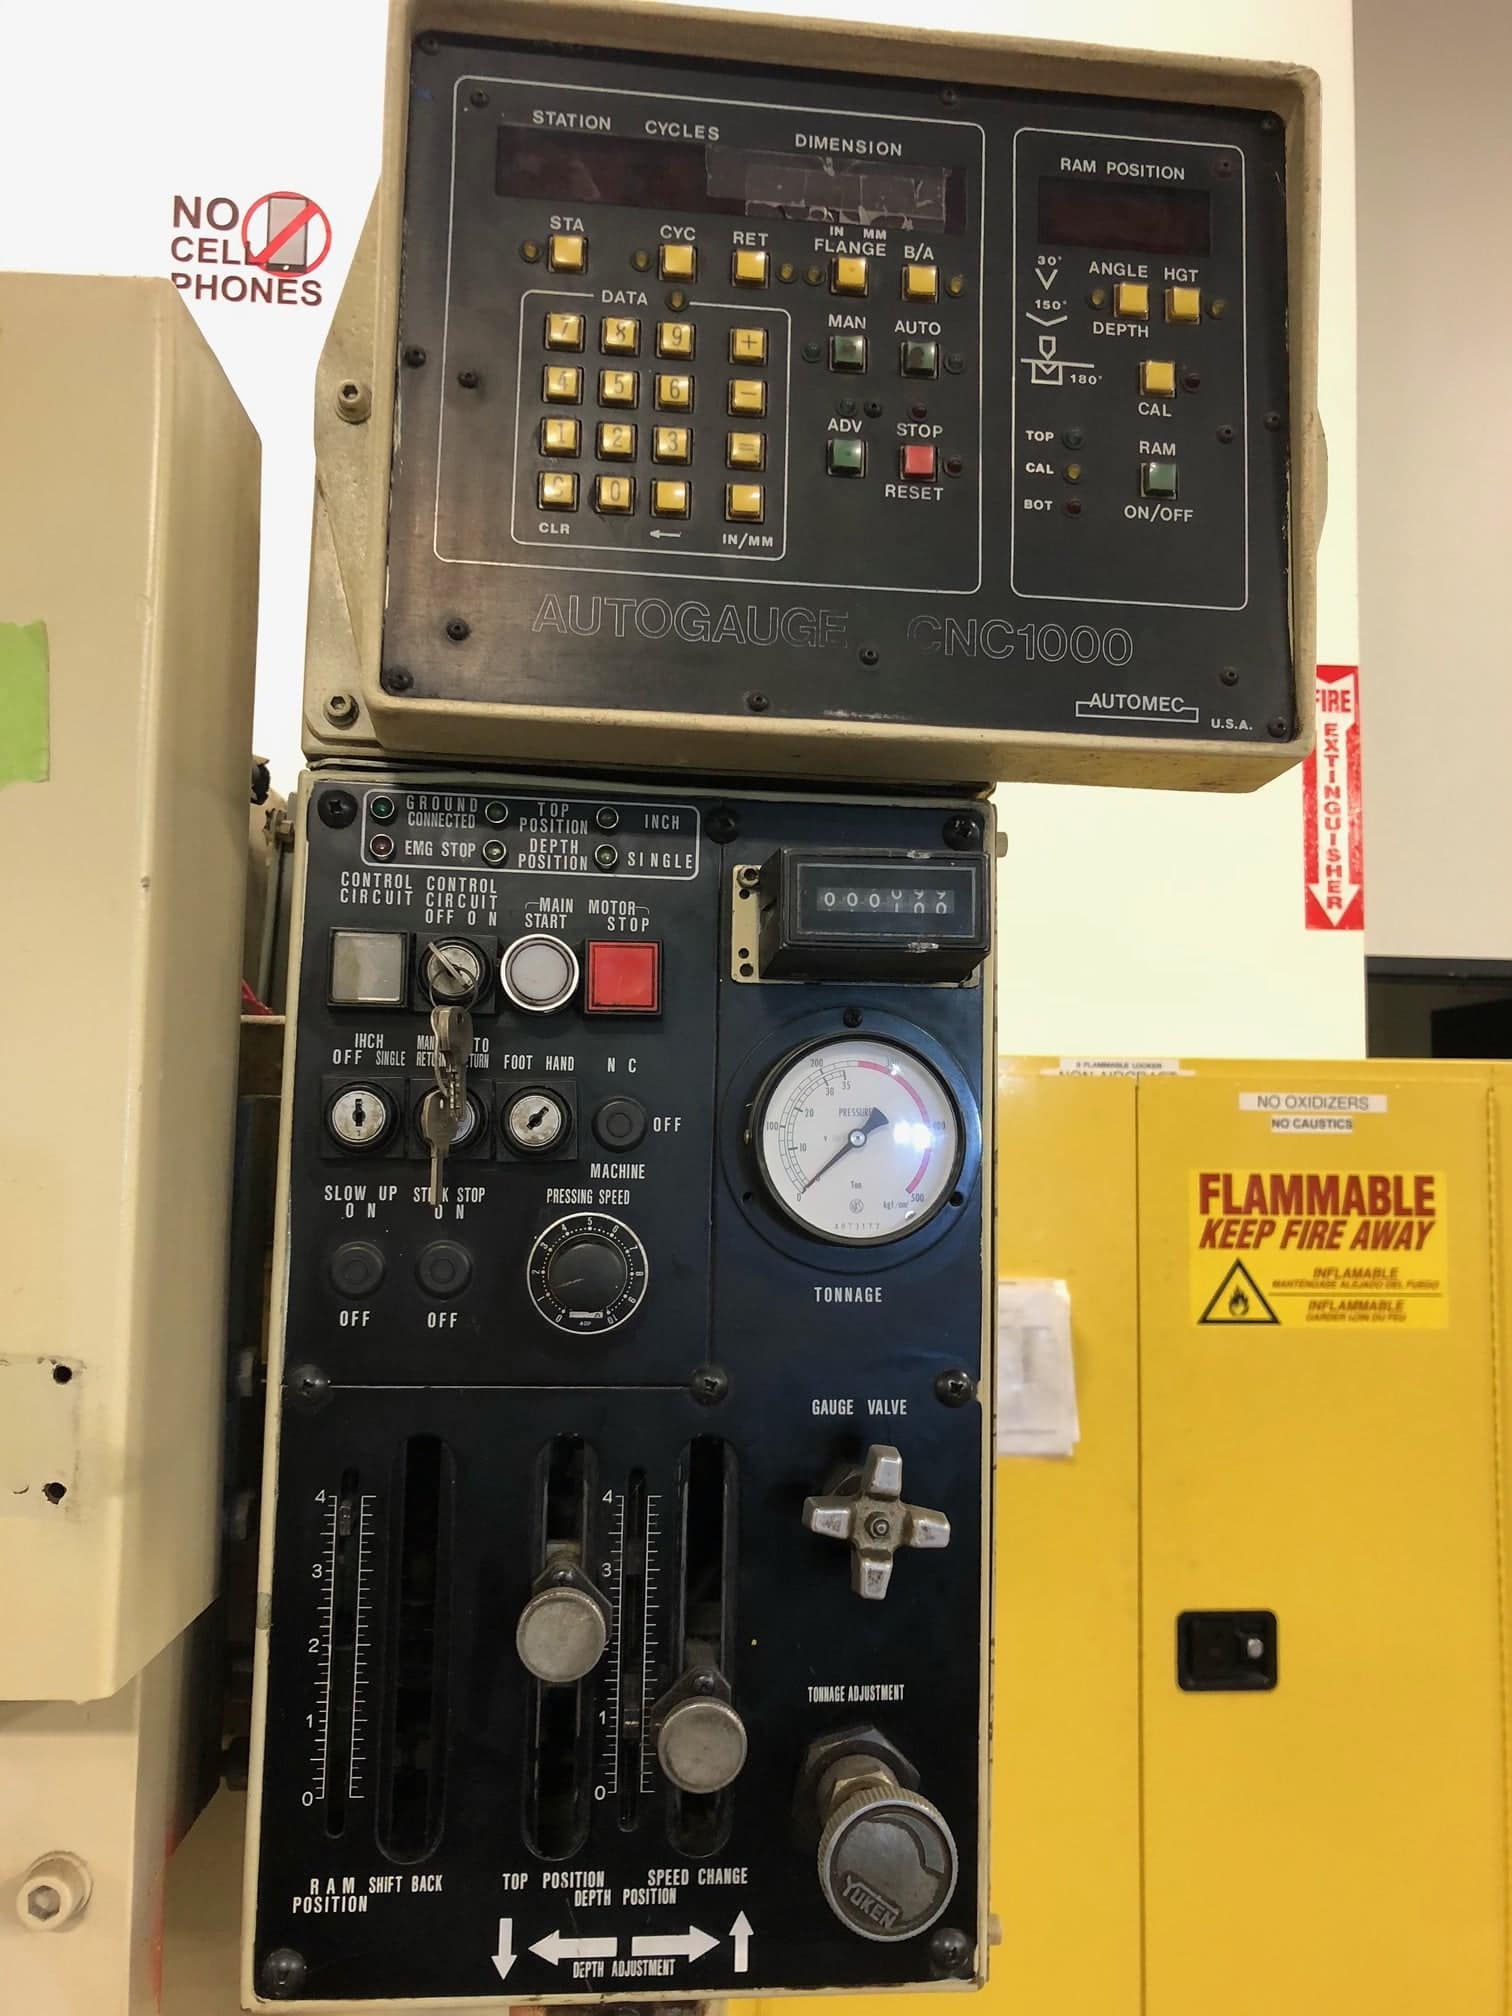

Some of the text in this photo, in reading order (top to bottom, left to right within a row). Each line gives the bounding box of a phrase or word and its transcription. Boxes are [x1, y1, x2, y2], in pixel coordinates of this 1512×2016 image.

[533, 109, 611, 131] STATION
[645, 120, 720, 142] CYCLES
[795, 133, 903, 157] DIMENSION
[1061, 157, 1185, 180] RAM POSITION
[173, 195, 240, 231] NO
[550, 216, 585, 233] STA
[660, 225, 696, 241] CYC
[830, 226, 887, 240] IN MM
[733, 231, 769, 247] RET
[171, 236, 261, 266] CELL
[814, 239, 887, 257] FLANGE
[904, 245, 935, 261] B/A
[1089, 261, 1148, 278] ANGLE
[1164, 267, 1199, 282] HGT
[171, 272, 322, 306] PHONES
[601, 290, 648, 306] DATA
[828, 314, 867, 330] MAN
[894, 320, 942, 336] AUTO
[1093, 321, 1149, 338] DEPTH
[672, 327, 682, 345] 9
[614, 373, 624, 392] 5
[670, 379, 680, 399] 6
[1138, 402, 1172, 417] CAL
[827, 418, 863, 433] ADV
[896, 423, 943, 438] STOP
[612, 428, 623, 448] 2
[668, 431, 678, 451] 3
[1026, 430, 1054, 442] TOP
[1139, 441, 1176, 456] RAM
[1026, 463, 1054, 474] CAL
[885, 484, 944, 500] RESET
[1024, 500, 1053, 511] BOT
[1124, 504, 1193, 522] ON/OFF
[539, 523, 570, 535] CLR
[722, 532, 774, 549] IN/MM
[531, 593, 1133, 666] AUTOGAUGE CNC1000
[1089, 693, 1185, 713] AUTOMEC
[1316, 689, 1351, 713] IRE
[1211, 718, 1253, 731] U.S.A.
[406, 795, 479, 813] GROUND
[537, 802, 569, 817] TOP
[408, 811, 476, 829] CONNECTED
[645, 814, 680, 830] INCH
[1323, 723, 1342, 909] EXTINGUISHER
[520, 818, 588, 835] POSITION
[405, 840, 476, 858] EMG STOP
[530, 838, 578, 854] DEPTH
[518, 854, 588, 871] POSITION
[628, 851, 693, 869] SINGLE
[340, 872, 413, 890] CONTROL
[427, 876, 497, 894] CONTROL
[340, 888, 414, 906] CIRCUIT
[426, 892, 498, 909] CIRCUIT
[539, 897, 637, 916] MAIN MOTOR
[425, 909, 454, 925] OFF
[525, 913, 567, 929] START
[607, 916, 650, 932] STOP
[332, 1049, 406, 1066] OFF SINGLE
[466, 1053, 489, 1068] TURN
[504, 1055, 575, 1071] FOOT HAND
[1257, 1095, 1369, 1110] NO OXIDIZERS
[653, 1117, 682, 1132] OFF
[1272, 1118, 1352, 1130] NO CAUSTICS
[590, 1163, 645, 1180] MACHINE
[324, 1184, 397, 1201] SLOW UP
[457, 1187, 486, 1203] STOP
[547, 1188, 630, 1205] PRESSING SPEED
[1199, 1173, 1436, 1217] FLAMMABLE
[1199, 1218, 1435, 1251] KEEP FIRE AWAY
[1313, 1266, 1399, 1279] INFLAMABLE
[814, 1286, 882, 1303] TONNAGE
[1308, 1300, 1404, 1312] INFLAMMABLE
[339, 1310, 370, 1327] OFF
[427, 1312, 458, 1328] OFF
[812, 1399, 907, 1416] GAUGE VALVE
[315, 1489, 327, 1503] 4
[602, 1490, 613, 1504] 4
[312, 1564, 323, 1578] 3
[601, 1563, 612, 1577] 3
[308, 1638, 320, 1653] 2
[848, 1684, 904, 1702] ADJUSTMENT
[306, 1714, 312, 1728] 1
[599, 1711, 606, 1725] 1
[302, 1792, 313, 1806] 0
[594, 1786, 606, 1800] 0
[369, 1875, 443, 1894] SHIFT BACK
[503, 1871, 605, 1890] TOP POSITION
[647, 1867, 748, 1887] SPEED CHANGE
[310, 1878, 355, 1895] RAM
[293, 1895, 368, 1914] POSITION
[574, 1887, 677, 1907] DEPTH POSITION
[842, 1874, 899, 1930] YUKEN
[573, 1959, 675, 1979] DEPTH ADJUSTMENT
